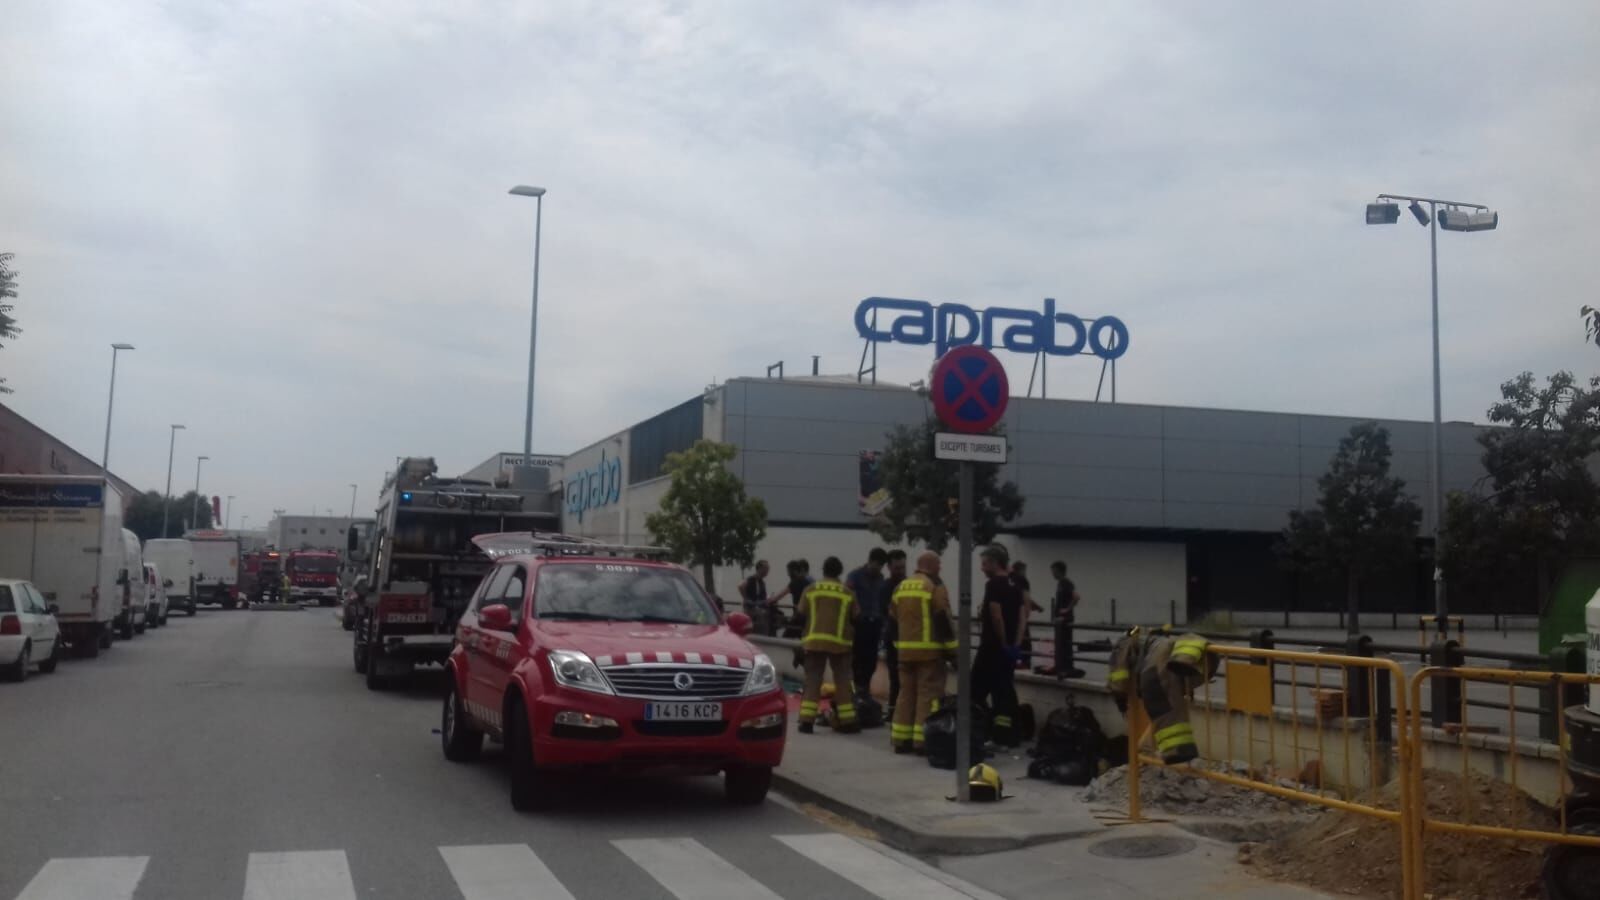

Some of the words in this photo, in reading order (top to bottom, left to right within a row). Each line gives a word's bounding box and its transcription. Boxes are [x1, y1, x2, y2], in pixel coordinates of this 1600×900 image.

[854, 296, 1129, 360] caprabo
[940, 440, 967, 452] EXCEPTE
[968, 442, 1001, 454] TURISMES
[566, 448, 622, 523] caprabo
[655, 702, 690, 719] 1416
[694, 703, 719, 719] KCP
